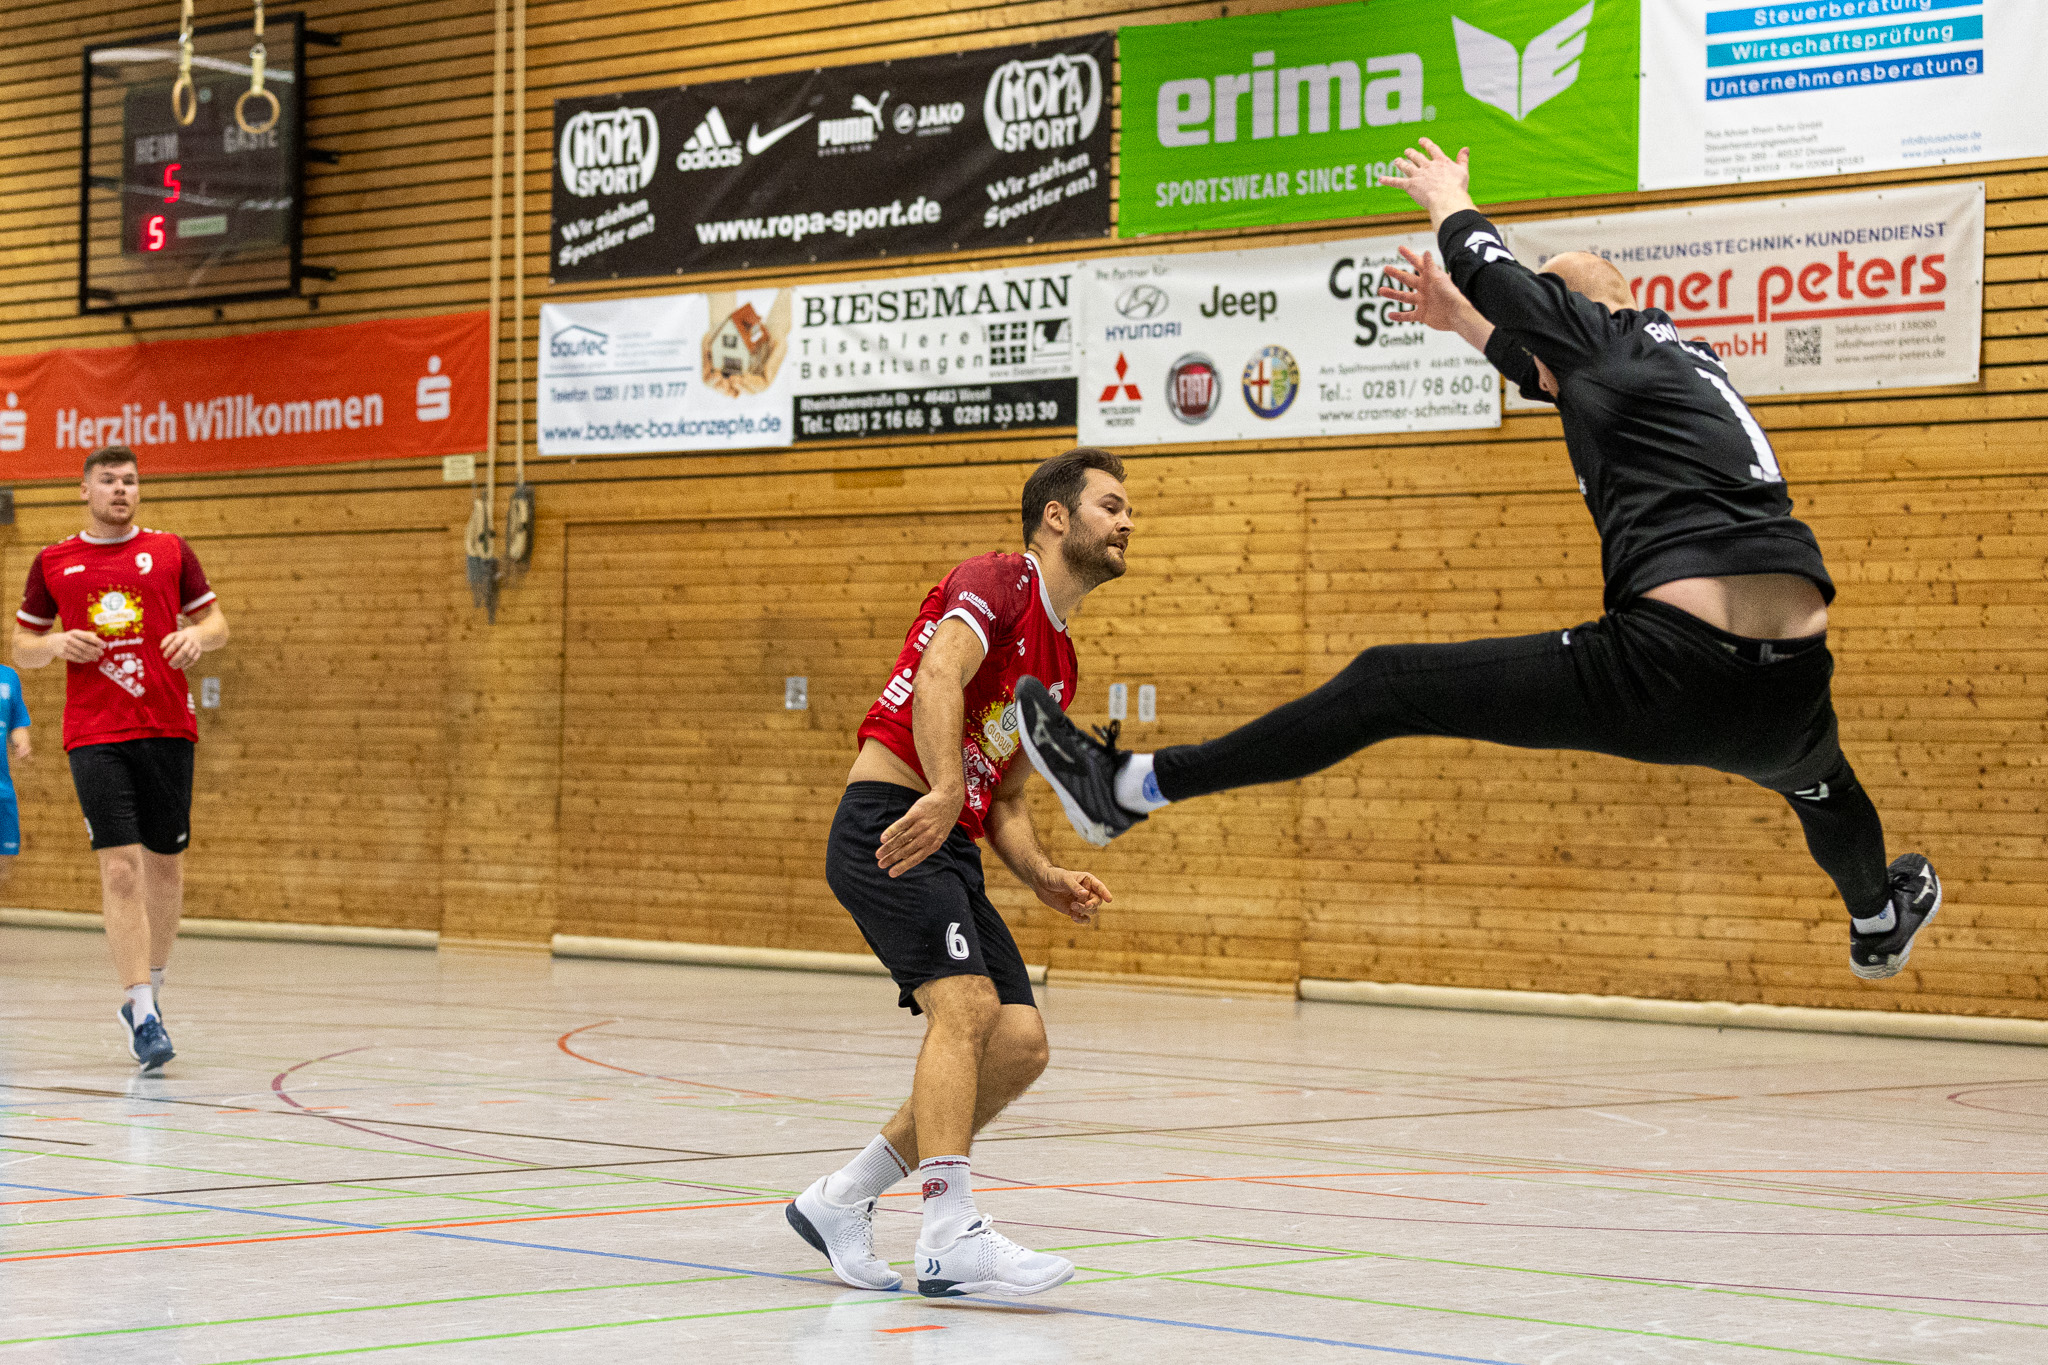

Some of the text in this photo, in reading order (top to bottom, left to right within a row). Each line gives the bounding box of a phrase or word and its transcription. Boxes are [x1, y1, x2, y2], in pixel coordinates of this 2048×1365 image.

[1754, 0, 1932, 27] Steuerberatung
[1732, 24, 1954, 61] Wirtschaftsprüfung
[1710, 56, 1978, 98] Unternehmensberatung
[917, 101, 965, 128] JAKO
[1157, 50, 1424, 148] erima
[817, 115, 874, 147] PUMA
[1004, 115, 1079, 153] SPORT
[676, 146, 743, 172] adidas
[985, 153, 1090, 202] Wir ziehen
[163, 163, 182, 204] 5
[577, 165, 643, 198] SPORT
[983, 168, 1098, 228] Sportler an!
[1156, 172, 1289, 208] SPORTSWEAR
[1296, 164, 1357, 195] SINCE
[148, 215, 166, 251] 5
[560, 217, 595, 242] Wir
[695, 196, 942, 245] www.ropa-sport.de
[558, 213, 655, 266] Sportler an!
[1622, 234, 1795, 263] HEIZUNGSTECHNIK
[1805, 222, 1946, 249] KUNDENDIENST
[803, 275, 1072, 329] BIESEMANN
[1200, 284, 1278, 323] Jeep
[1756, 249, 1948, 323] peters
[801, 327, 988, 356] Tischlerei
[1105, 322, 1182, 341] HYUNDAI
[1378, 331, 1425, 348] GmbH
[801, 354, 983, 382] Bestattungen
[1422, 375, 1444, 397] 98
[1450, 373, 1493, 395] 60-0
[55, 391, 384, 450] Herzlich Willkommen
[870, 410, 882, 430] 2
[135, 552, 153, 575] 9
[986, 723, 1013, 755] GLOBUS
[945, 922, 970, 960] 6
